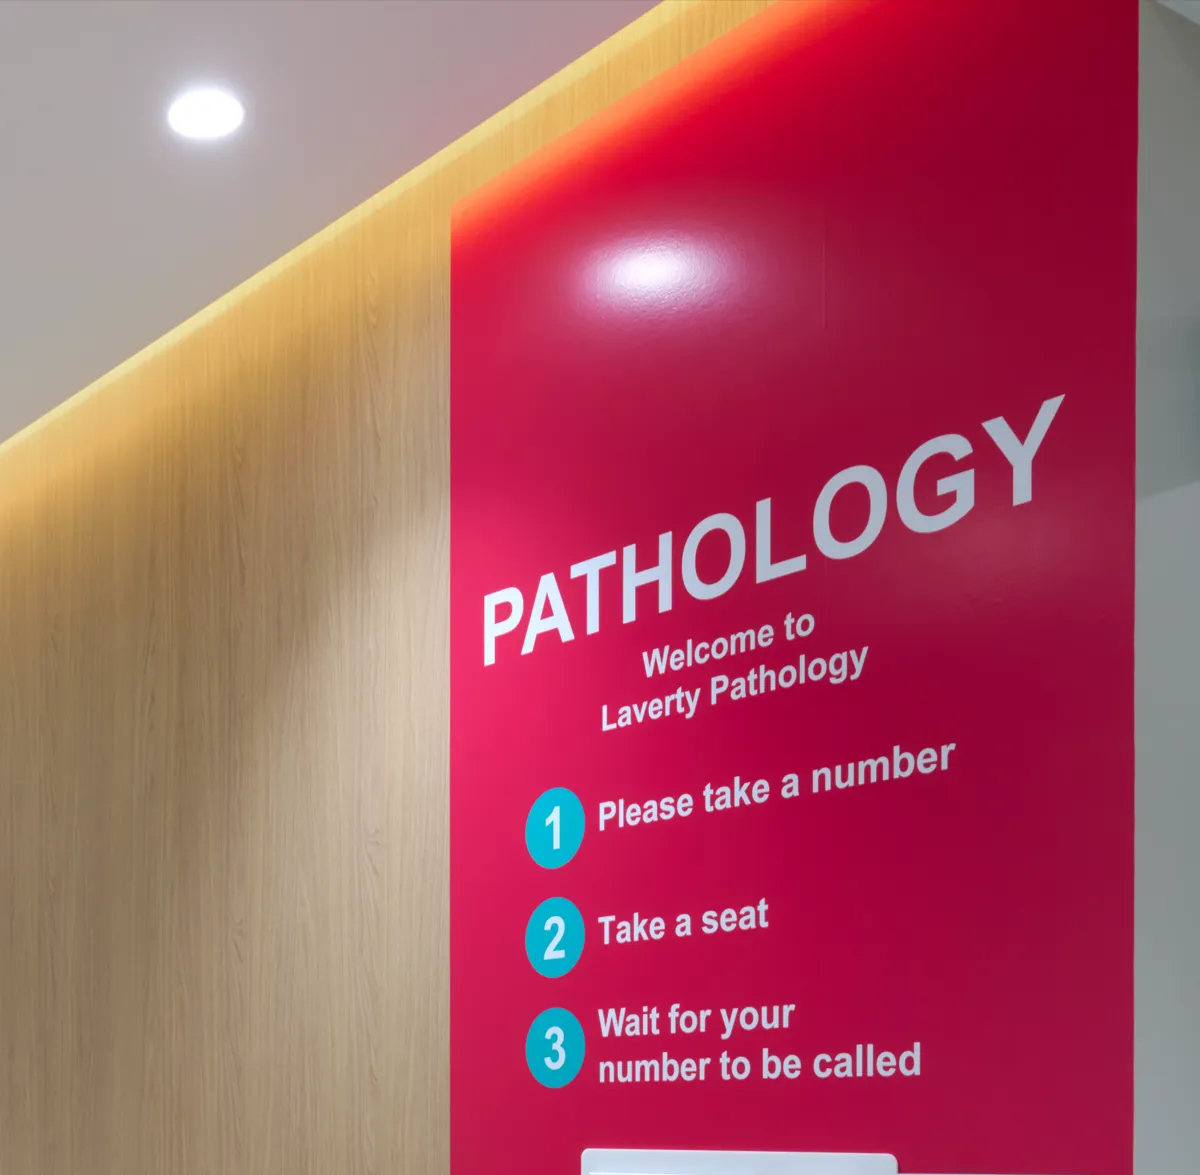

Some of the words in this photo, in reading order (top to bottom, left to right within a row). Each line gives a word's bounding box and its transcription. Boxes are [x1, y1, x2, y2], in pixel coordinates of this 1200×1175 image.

[483, 394, 1065, 666] PATHOLOGY
[641, 625, 774, 677] Welcome
[784, 611, 815, 641] to
[601, 688, 700, 731] Laverty
[710, 646, 868, 705] Pathology
[545, 805, 560, 850] 1
[600, 793, 694, 831] Please
[702, 776, 770, 813] take
[781, 772, 800, 798] a
[812, 742, 956, 794] number
[543, 915, 566, 960] 2
[598, 912, 666, 945] Take
[675, 913, 692, 937] a
[701, 898, 769, 934] seat
[544, 1026, 566, 1070] 3
[598, 1006, 660, 1038] Wait
[668, 1003, 711, 1034] for
[720, 1002, 796, 1040] your
[599, 1052, 711, 1084] number
[720, 1051, 750, 1080] to
[762, 1048, 802, 1080] be
[813, 1042, 922, 1078] called
